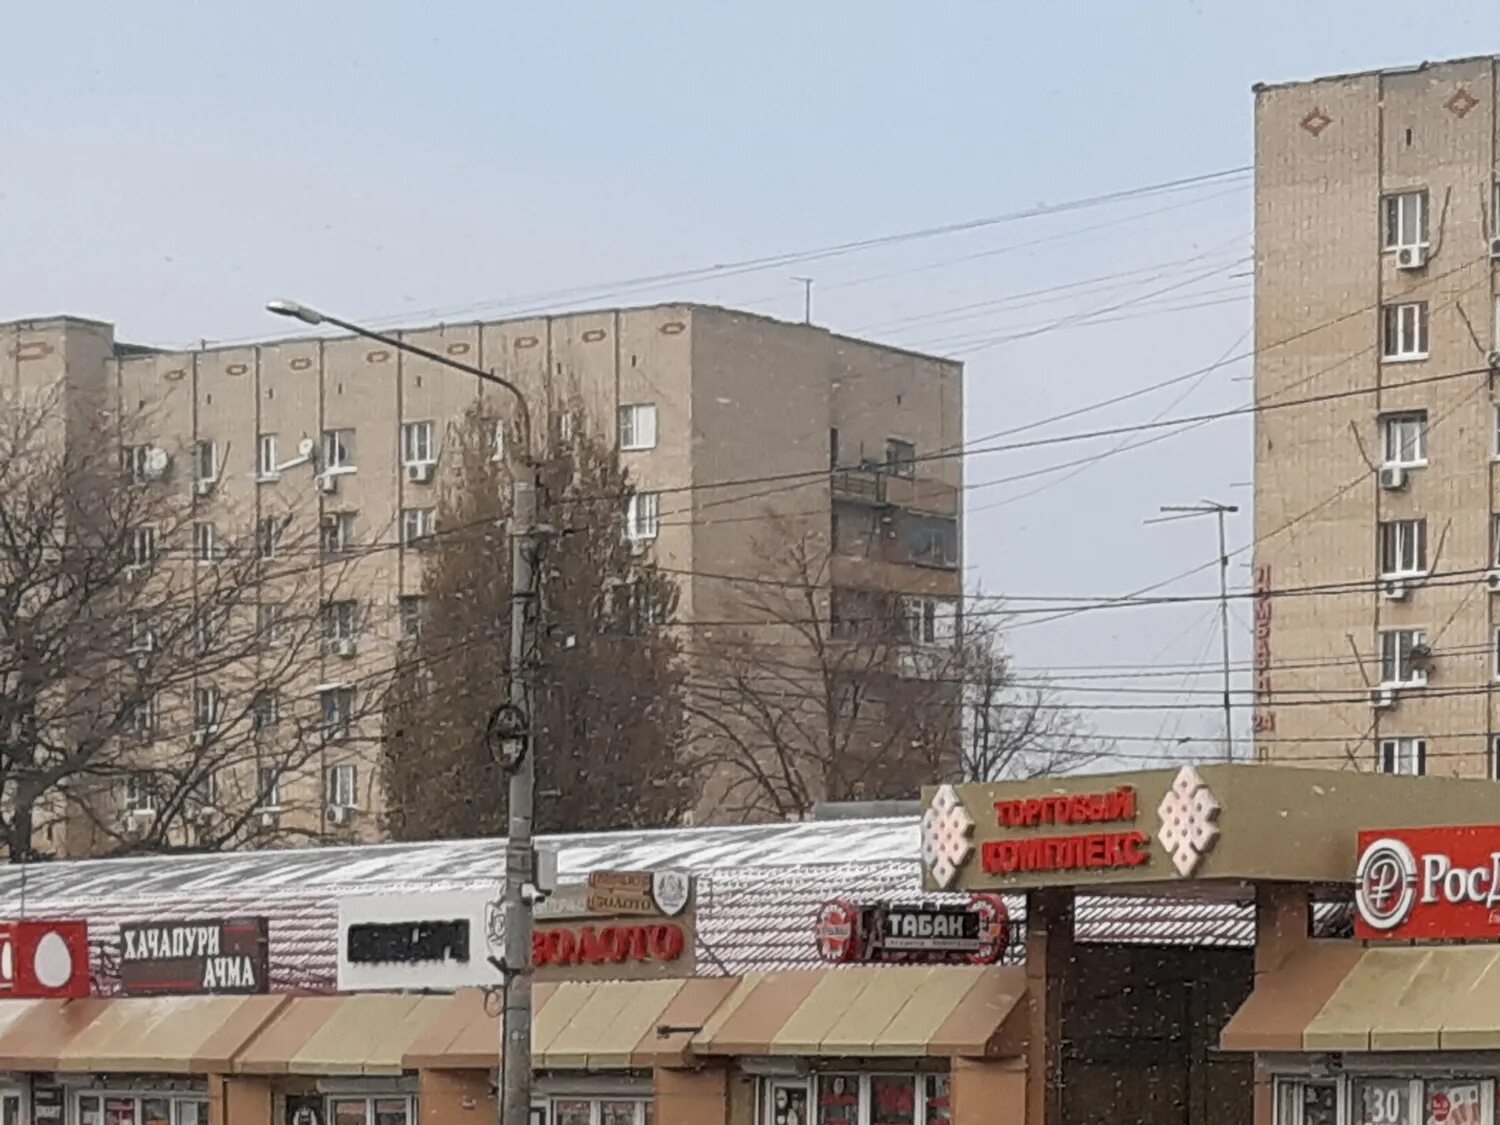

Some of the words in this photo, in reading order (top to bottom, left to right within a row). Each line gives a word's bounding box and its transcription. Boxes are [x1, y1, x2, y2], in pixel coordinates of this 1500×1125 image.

[994, 786, 1137, 825] ТОРГОВЫЙ
[982, 831, 1149, 876] КОМПЛЕКС
[889, 914, 964, 937] ТАБАК
[124, 926, 220, 959] ХАЧАПУРИ
[202, 956, 255, 988] АЧМА
[1372, 1088, 1400, 1122] 30
